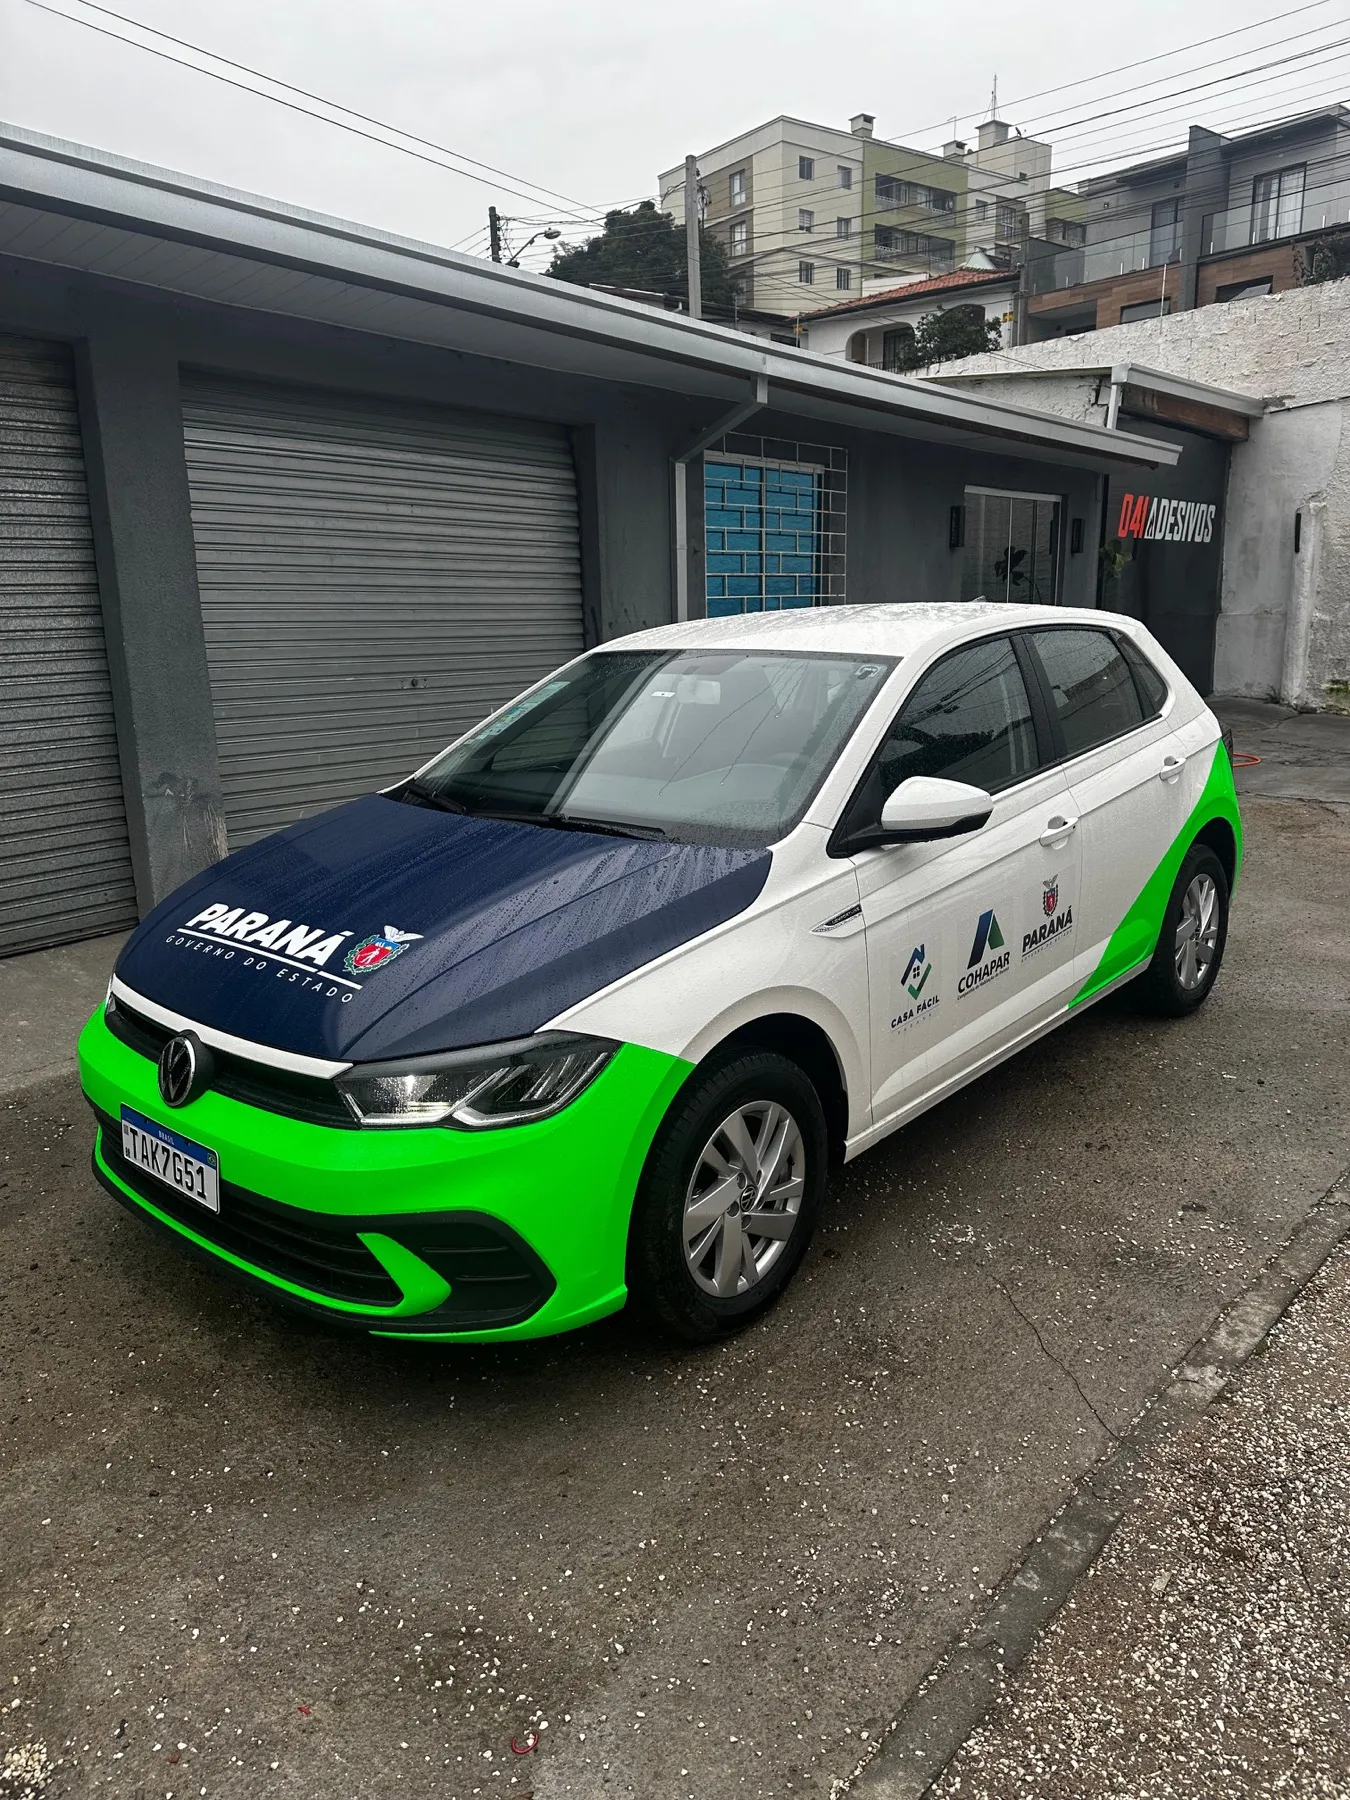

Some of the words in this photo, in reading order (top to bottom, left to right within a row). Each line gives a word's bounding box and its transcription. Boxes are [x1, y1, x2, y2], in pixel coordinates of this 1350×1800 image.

[185, 903, 355, 966] PARANÁ
[1022, 905, 1073, 953] PARANÁ
[166, 934, 235, 960] GOVERNO
[243, 957, 266, 970] DO
[276, 968, 353, 1003] ESTADO
[958, 951, 1010, 993] COHAPAR
[891, 1009, 914, 1028] CASA
[916, 995, 940, 1014] FÁCIL
[130, 1127, 207, 1201] TAK7G51
